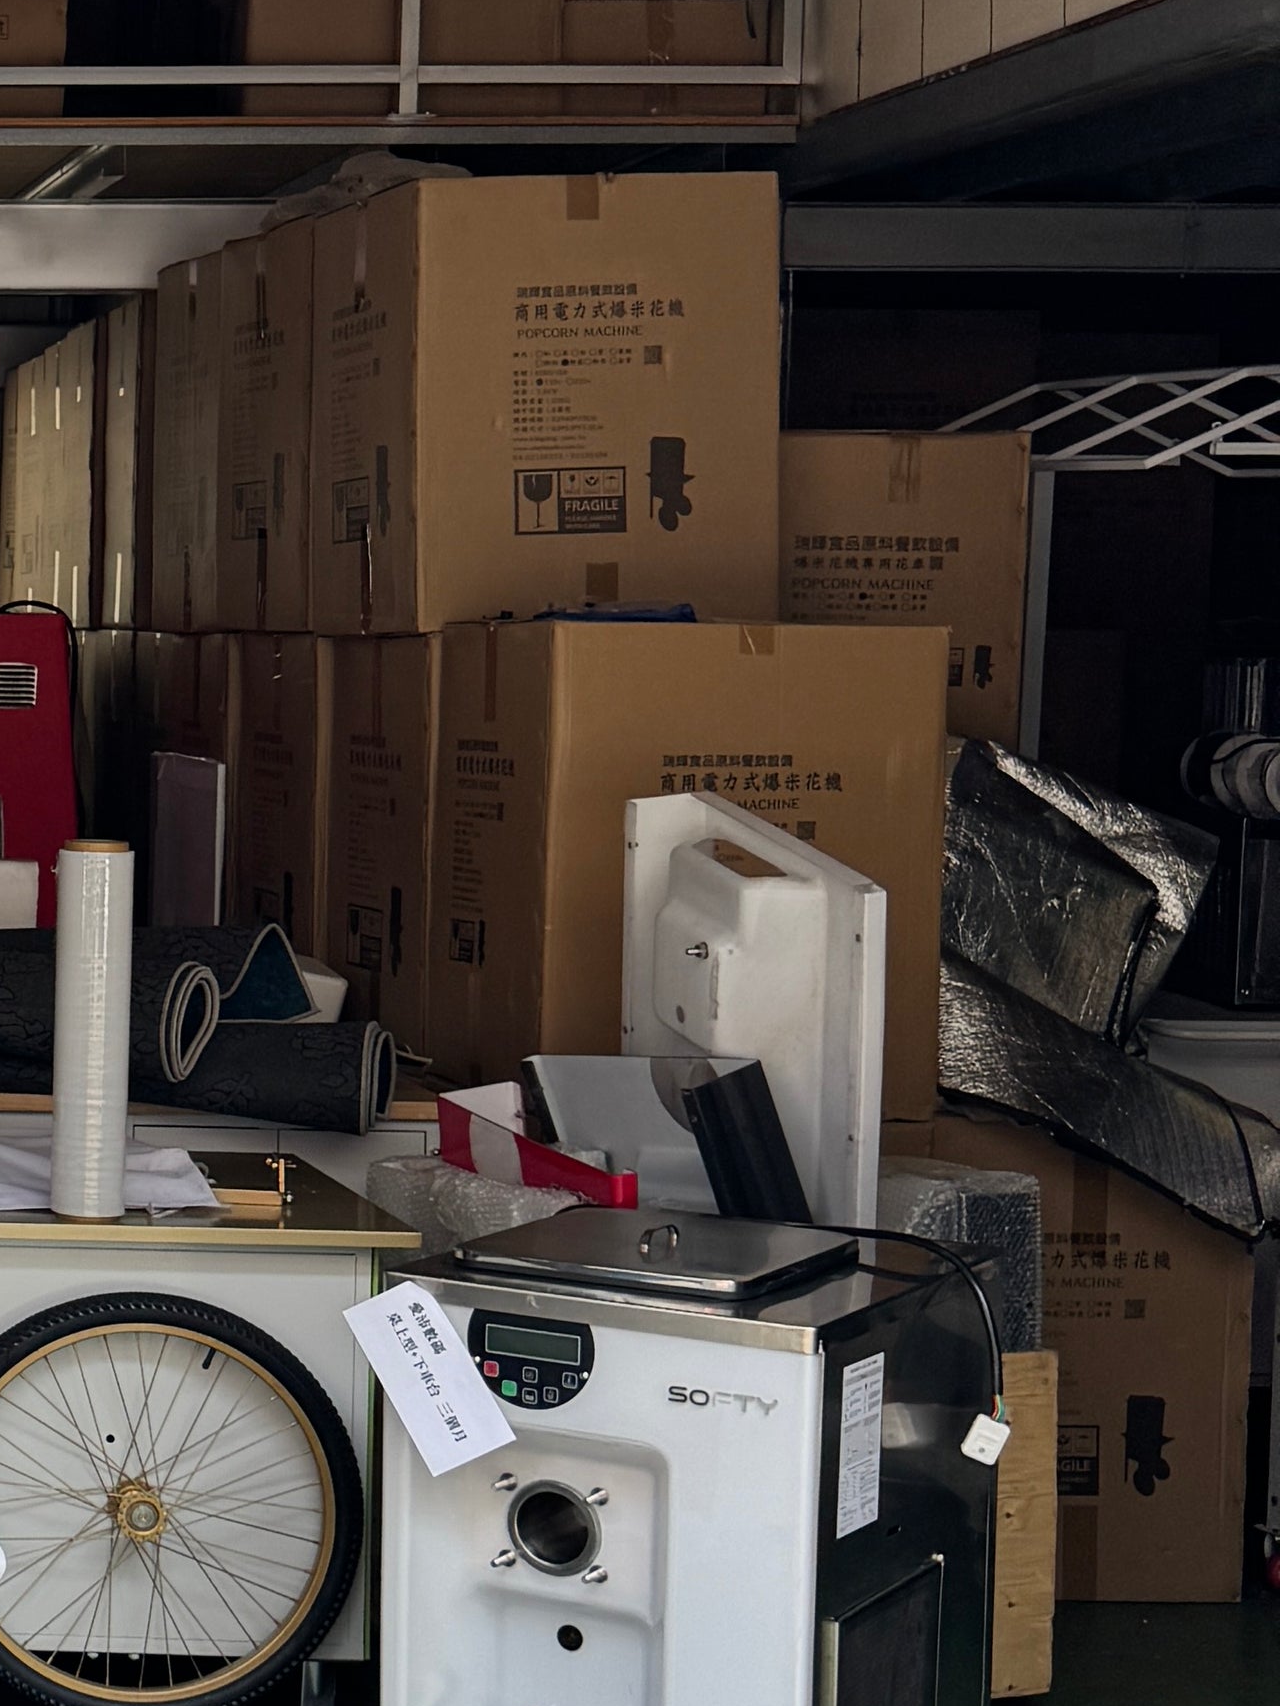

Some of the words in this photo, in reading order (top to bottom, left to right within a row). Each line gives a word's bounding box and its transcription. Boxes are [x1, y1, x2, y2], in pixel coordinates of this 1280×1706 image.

[515, 298, 685, 322] 商用電力式爆米花機
[517, 327, 578, 339] POPCORN
[584, 325, 642, 337] MACHINE
[564, 499, 619, 511] FRAGILE
[795, 535, 959, 552] 瑞輝食品原料餐飲設備
[792, 578, 861, 590] POPCORN
[868, 579, 934, 590] MACHINE
[661, 773, 843, 791] 商用電力式爆米花機
[1041, 1251, 1171, 1270] 力式爆米花機
[1061, 1277, 1124, 1289] MACHINE
[668, 1385, 779, 1416] SOFTY
[436, 1401, 468, 1443] 三個月
